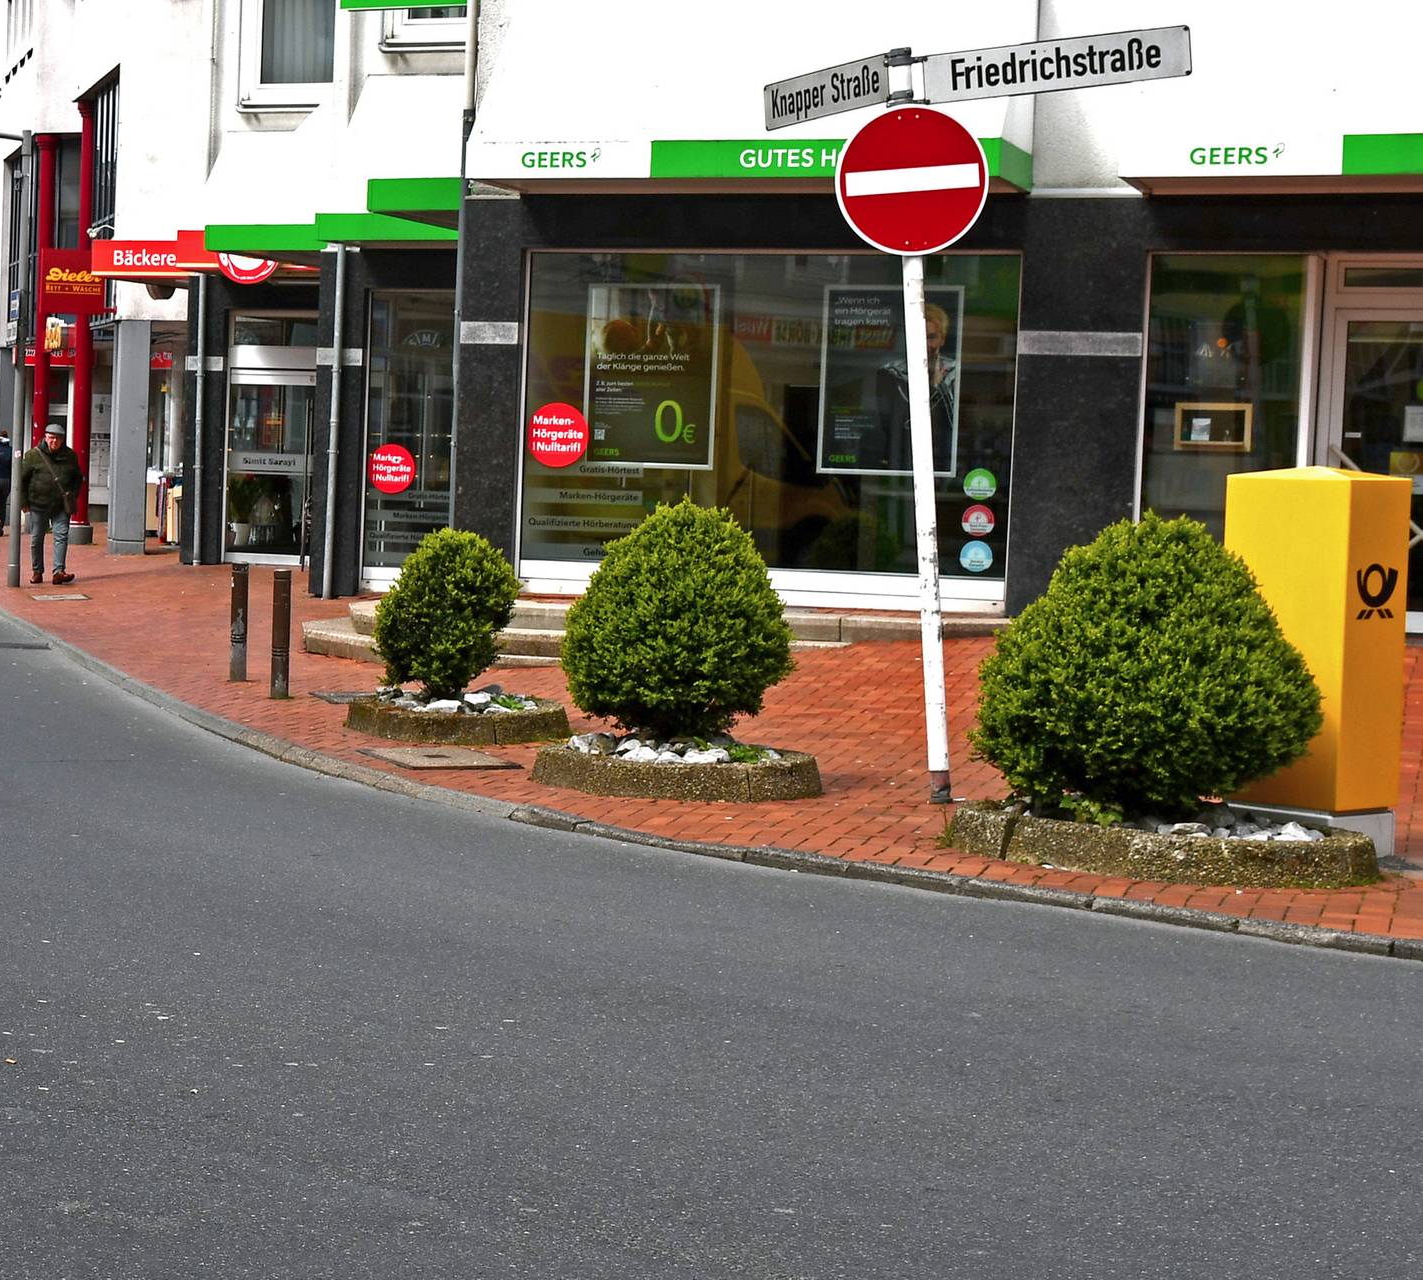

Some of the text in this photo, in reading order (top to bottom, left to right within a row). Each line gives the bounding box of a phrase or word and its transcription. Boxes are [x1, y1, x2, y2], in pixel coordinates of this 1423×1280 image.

[950, 37, 1162, 92] Friedrichstraße
[771, 64, 880, 121] Knapper Straße
[521, 150, 587, 169] GEERS
[739, 147, 815, 169] GUTES
[1189, 146, 1268, 166] GEERS
[627, 352, 642, 361] die
[642, 354, 669, 362] ganze
[670, 352, 690, 361] Welt
[596, 361, 611, 371] der
[533, 415, 575, 426] Marken-
[532, 428, 584, 441] Hörgeräte
[372, 463, 411, 474] Hörgeräte
[579, 465, 640, 474] Gratis-Hörtest
[559, 491, 639, 502] Marken-Hörgeräte
[528, 517, 582, 527] Qualifizierte
